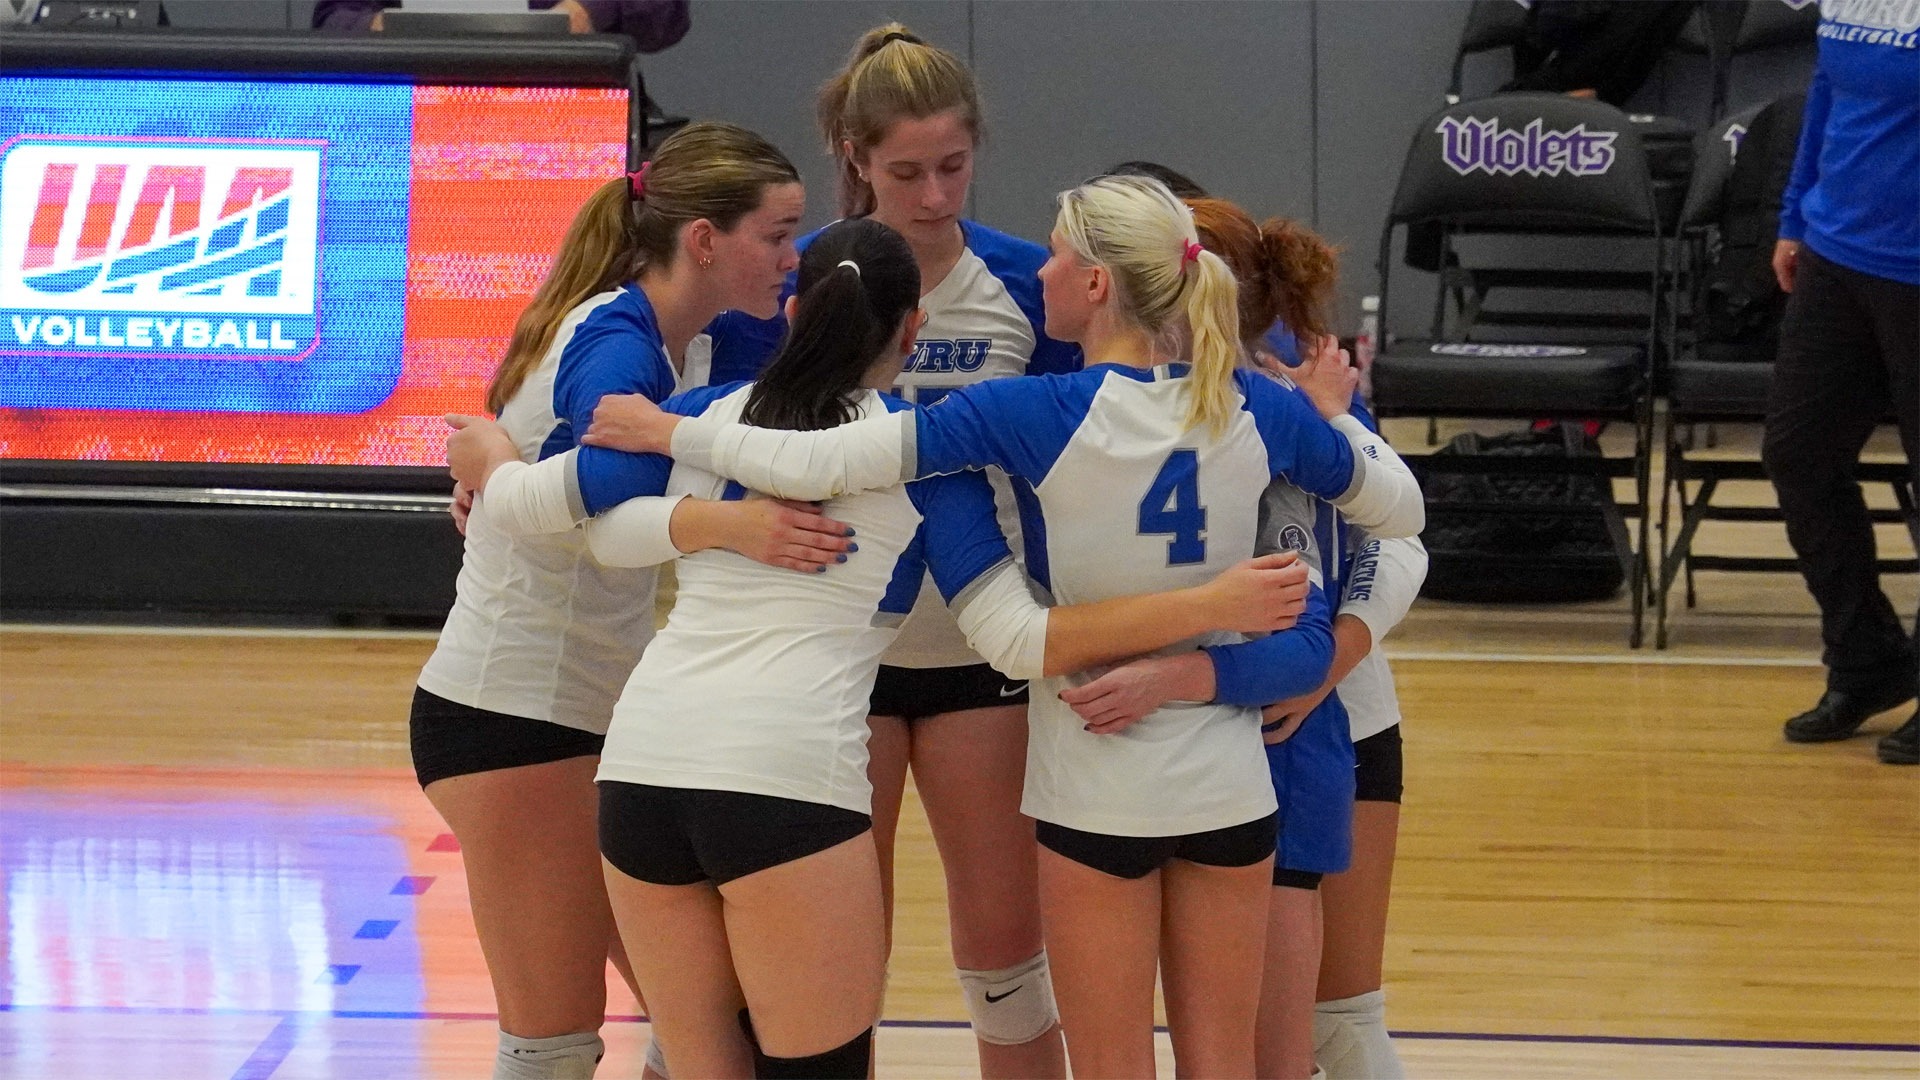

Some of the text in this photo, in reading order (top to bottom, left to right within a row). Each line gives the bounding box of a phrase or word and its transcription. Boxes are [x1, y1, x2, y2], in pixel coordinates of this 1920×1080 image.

[1436, 116, 1619, 177] Violets
[20, 162, 294, 297] UAA
[11, 315, 297, 350] VOLLEYBALL
[1136, 447, 1208, 568] 4
